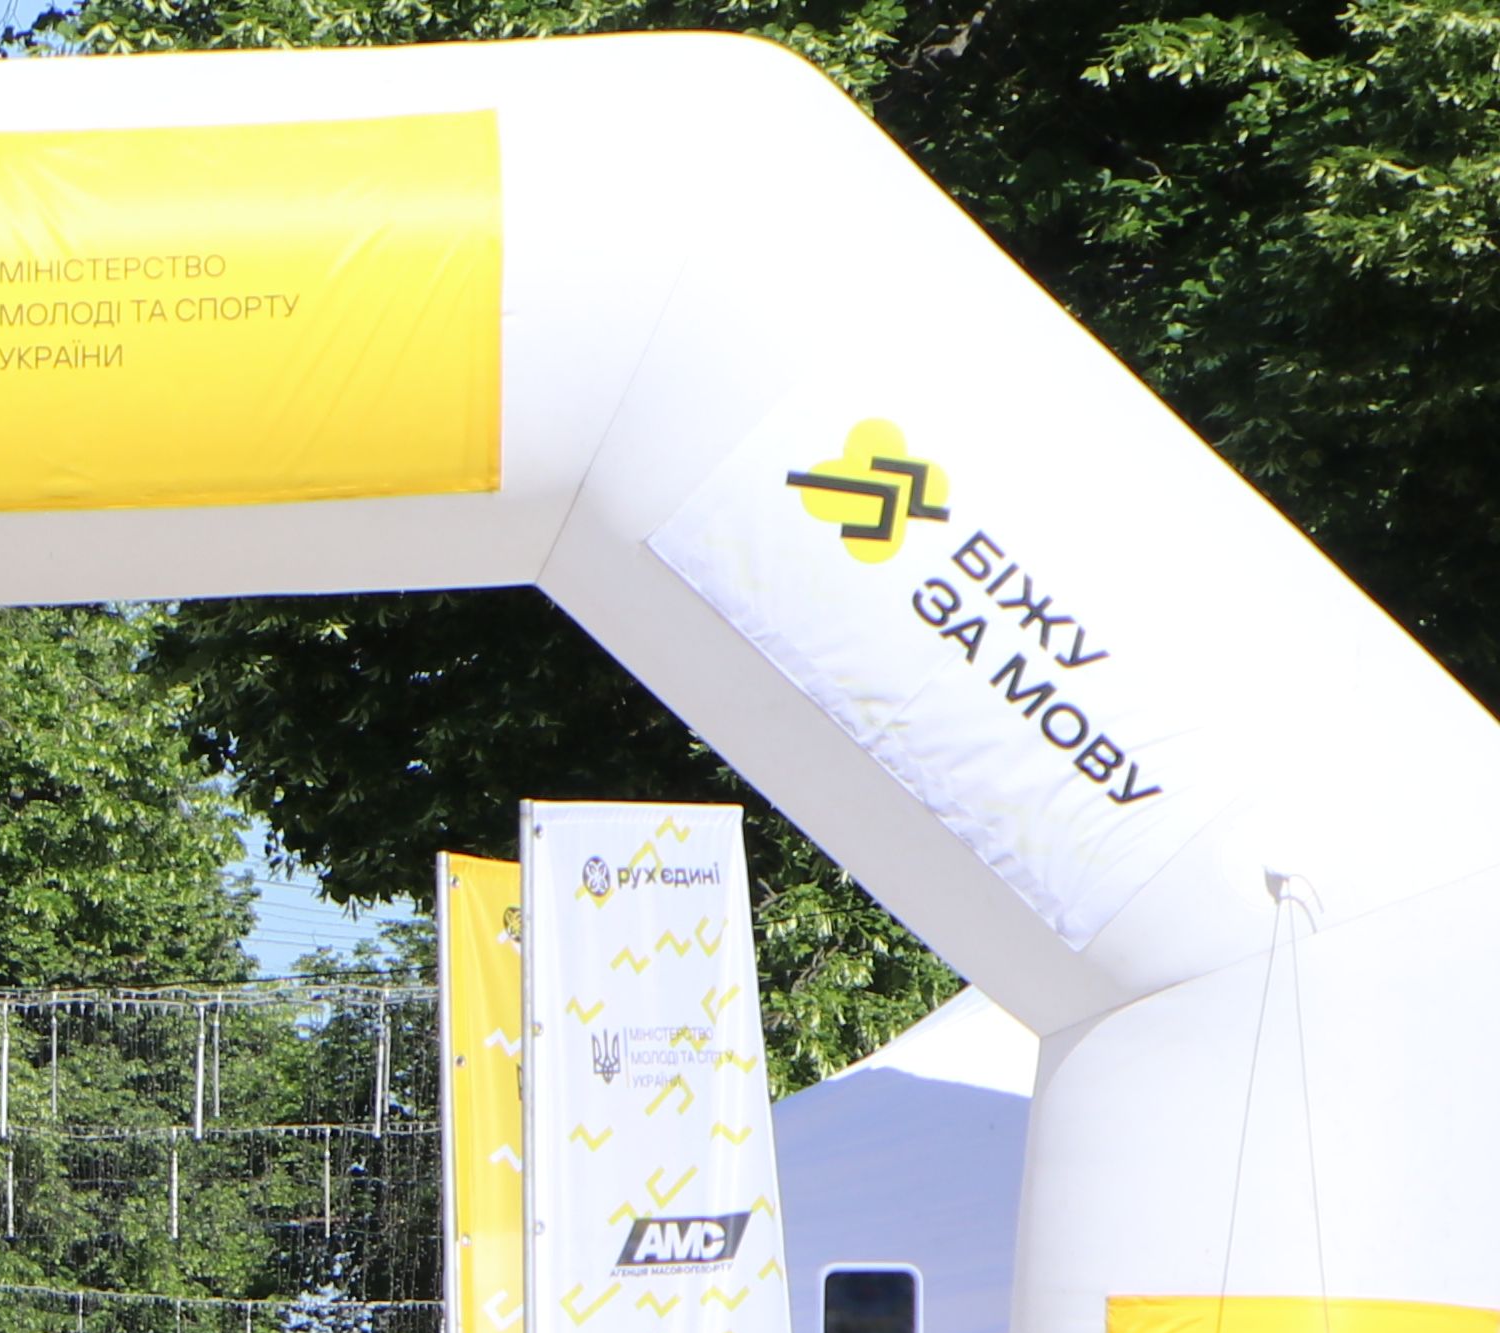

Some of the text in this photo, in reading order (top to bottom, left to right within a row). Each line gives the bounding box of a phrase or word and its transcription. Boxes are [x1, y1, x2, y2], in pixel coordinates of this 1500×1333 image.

[0, 254, 226, 283] МІНІСТЕРСТВО
[0, 294, 300, 328] МОЛОДІ ТА СПОРТУ
[951, 529, 1111, 669] БІЖУ
[912, 577, 1163, 805] ЗА МОВУ
[617, 862, 721, 889] рух єдині
